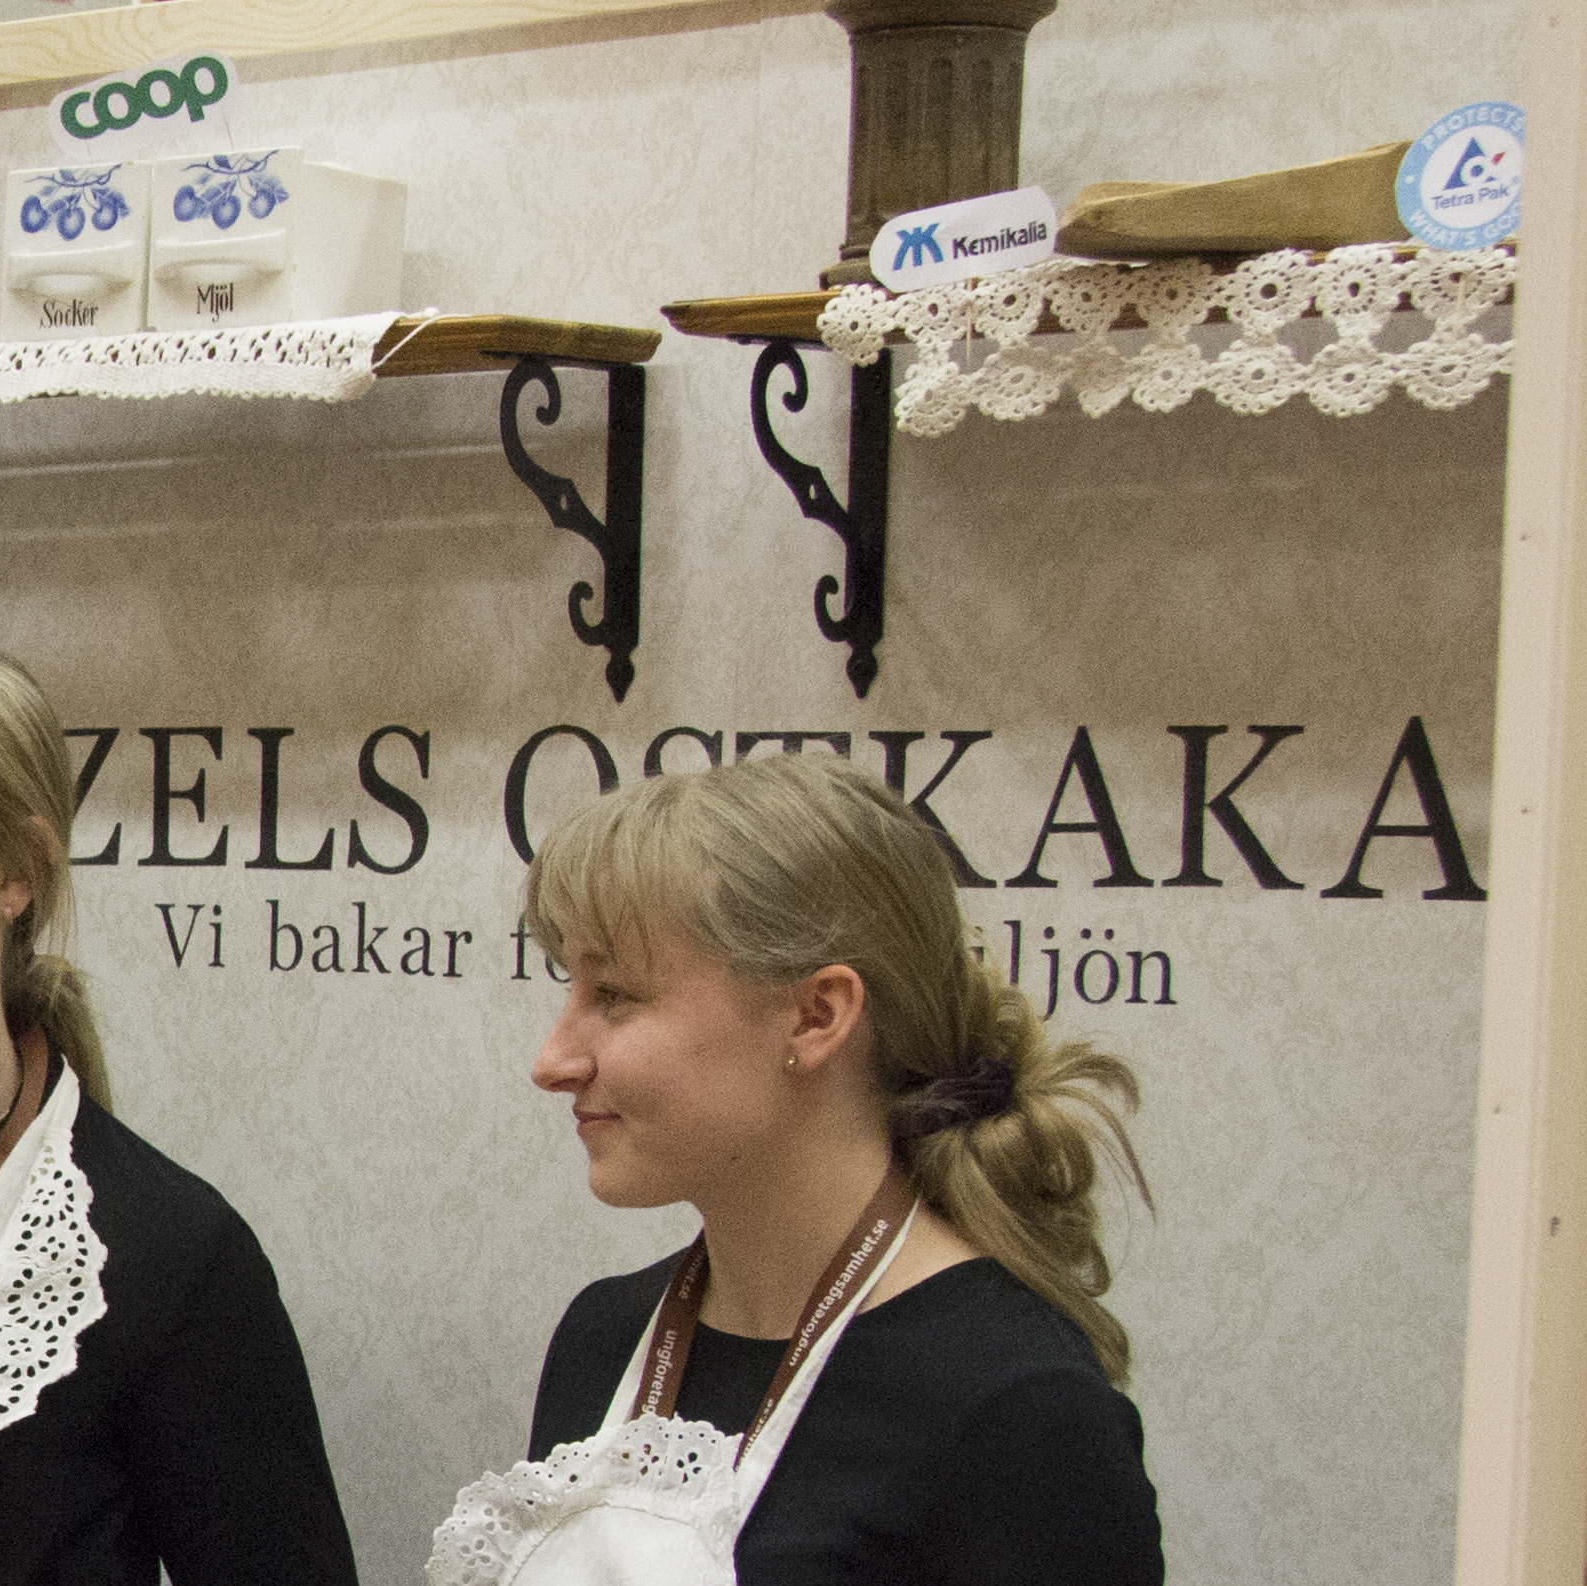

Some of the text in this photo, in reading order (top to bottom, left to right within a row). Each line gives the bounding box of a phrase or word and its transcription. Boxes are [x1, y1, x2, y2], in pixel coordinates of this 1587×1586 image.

[60, 55, 229, 140] coop
[1431, 184, 1509, 210] Tetra Pak
[952, 220, 1048, 260] Kemikalia
[1409, 209, 1478, 246] WHAT'S
[39, 297, 98, 329] Socker
[196, 282, 234, 322] Mjöl
[504, 715, 1488, 901] OKAKA
[154, 903, 226, 968] Vi
[265, 899, 473, 978] bakar
[789, 1218, 889, 1367] ungforetagsamhet.se
